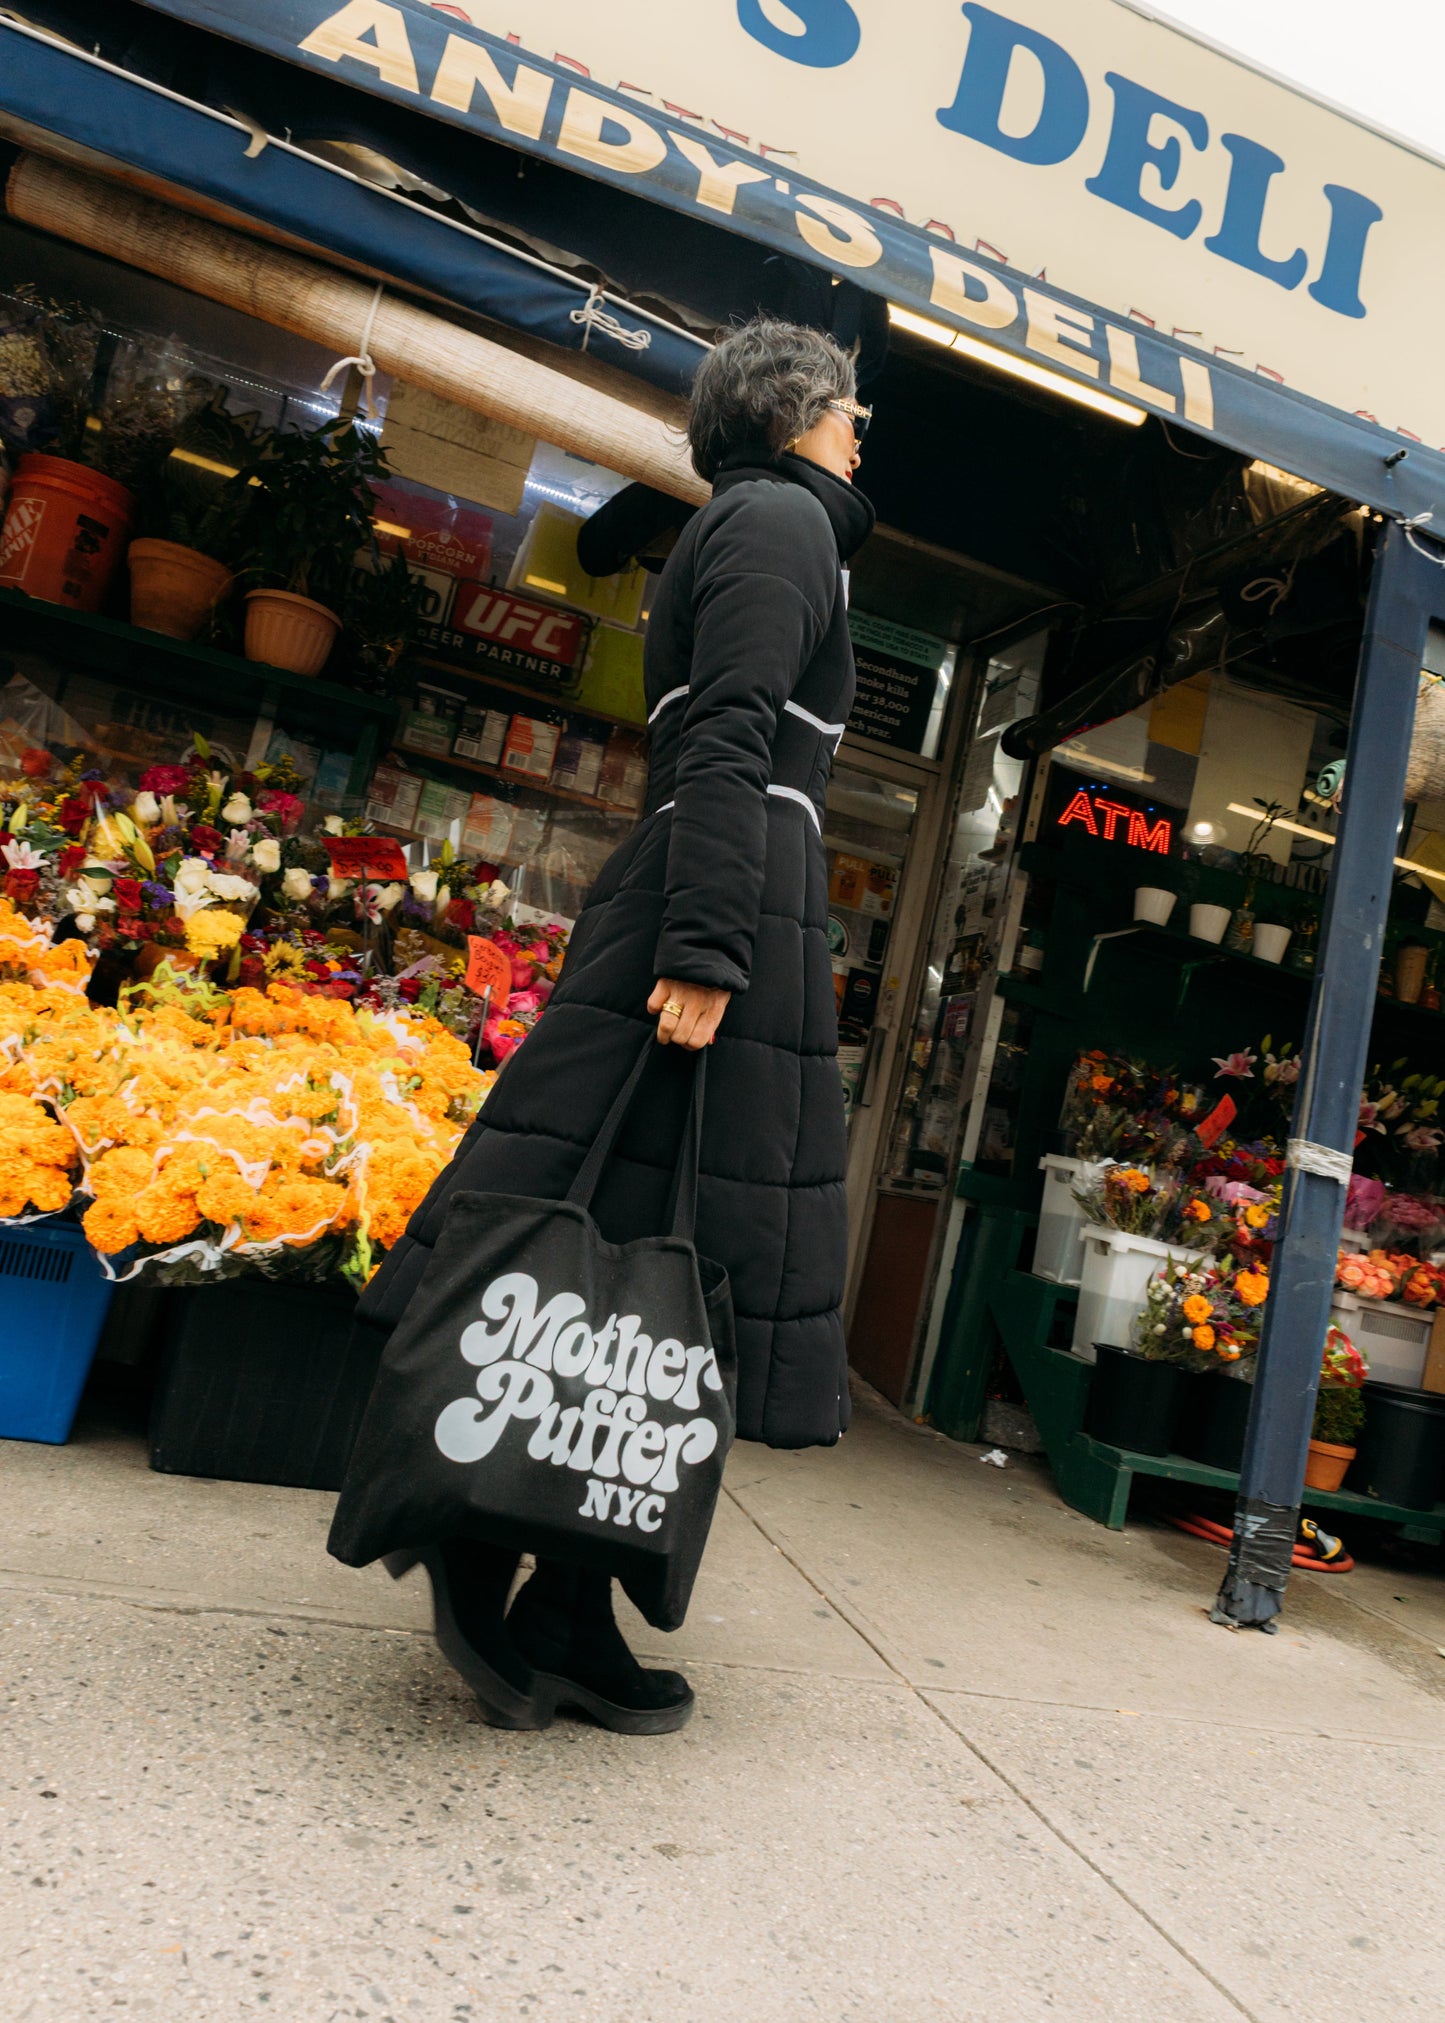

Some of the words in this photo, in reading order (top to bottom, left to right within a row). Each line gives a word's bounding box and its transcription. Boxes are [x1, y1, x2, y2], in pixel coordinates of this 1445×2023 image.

[935, 2, 1382, 319] DELI
[297, 0, 882, 269] ANDY'S
[929, 245, 1215, 431] DELI
[837, 399, 867, 417] FENDI
[407, 537, 477, 564] POPCORN
[464, 593, 575, 654] UFC
[476, 641, 561, 678] PARTNER
[856, 657, 919, 686] Secondhand
[856, 674, 886, 690] moke
[887, 682, 910, 698] kills
[856, 690, 871, 701] ver
[871, 694, 910, 714] 38,000
[846, 718, 865, 731] ach
[852, 705, 901, 727] mericans
[1057, 791, 1172, 856] ATM
[838, 856, 865, 872] PULL
[870, 867, 897, 883] PULL
[460, 1272, 723, 1411] Mother
[434, 1360, 718, 1492] Puffer
[578, 1478, 666, 1533] NYC
